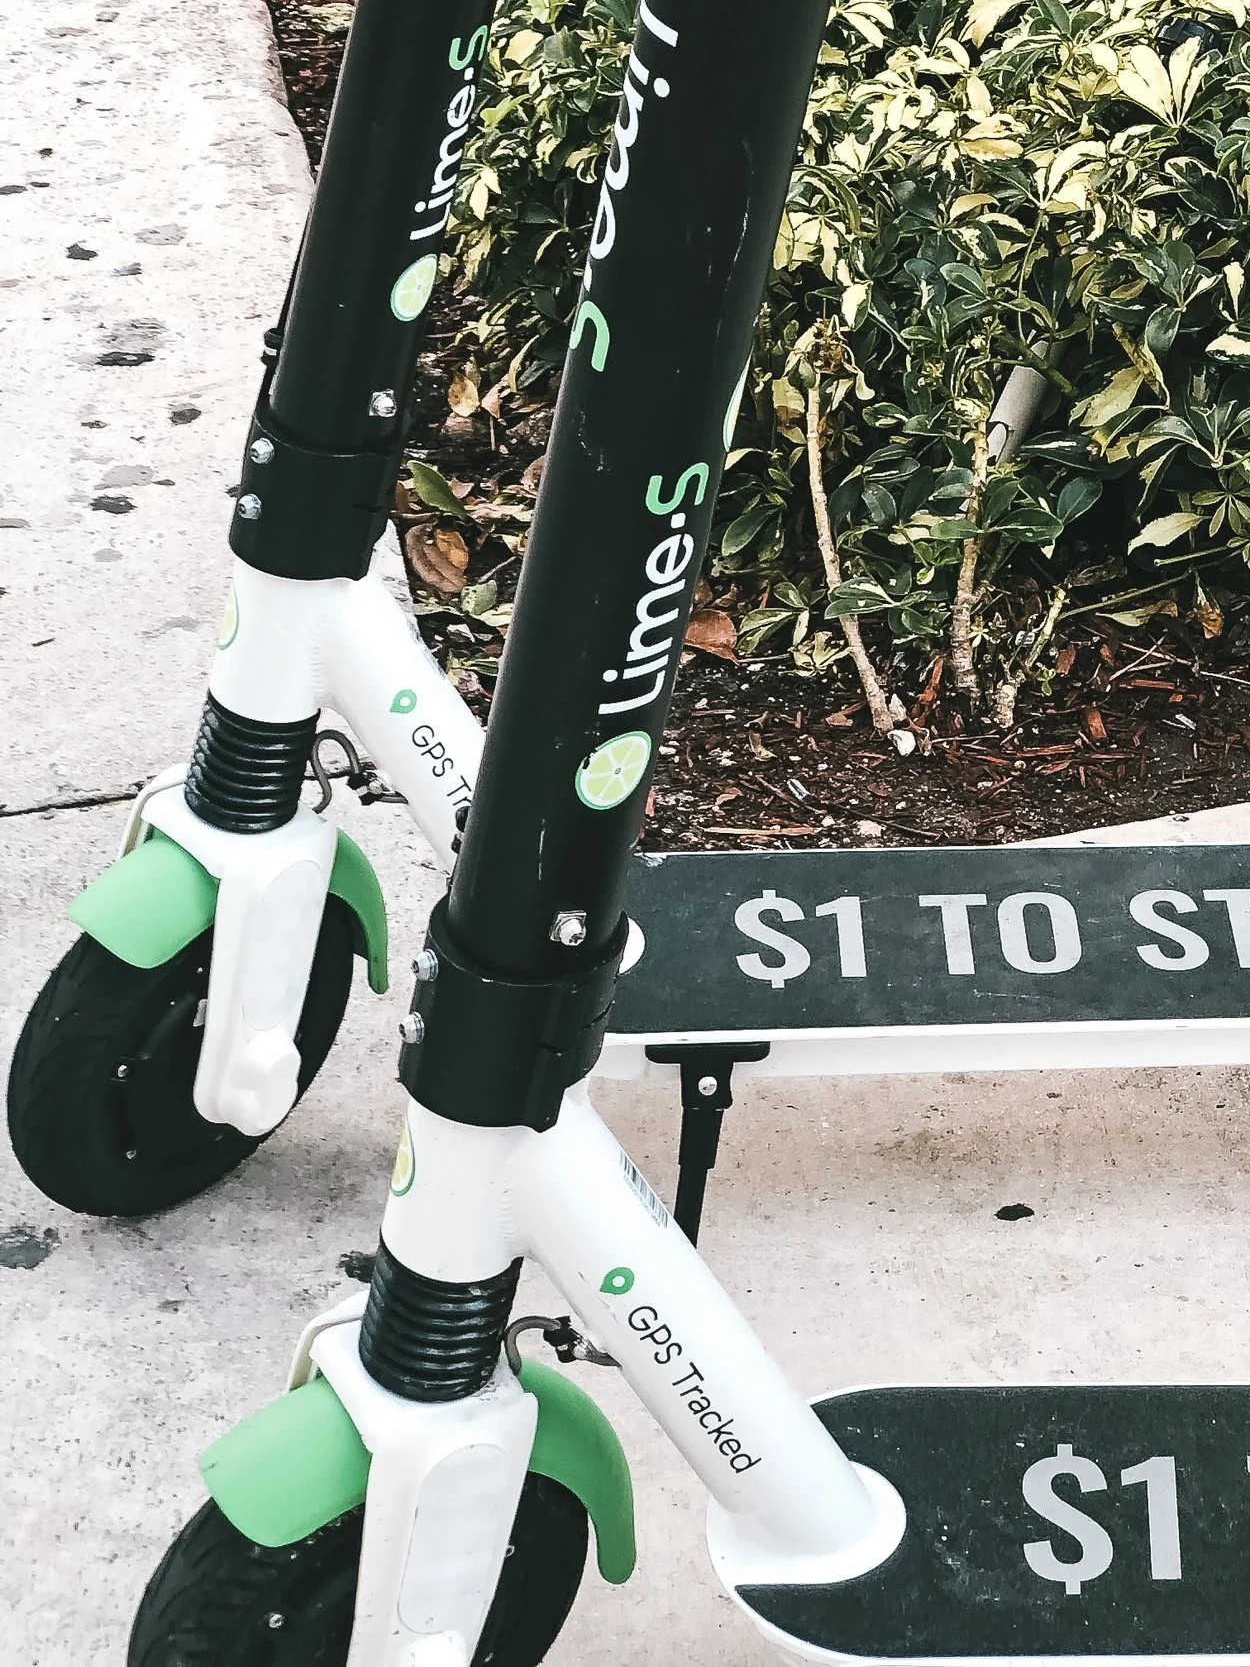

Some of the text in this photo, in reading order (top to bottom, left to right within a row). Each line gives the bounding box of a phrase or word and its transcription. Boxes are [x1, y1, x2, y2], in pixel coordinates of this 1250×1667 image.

[412, 724, 454, 777] GPS
[733, 888, 868, 989] $1
[919, 891, 1082, 975] TO
[628, 1306, 682, 1364] GPS
[672, 1362, 762, 1474] Tracked
[1021, 1443, 1182, 1594] $1
